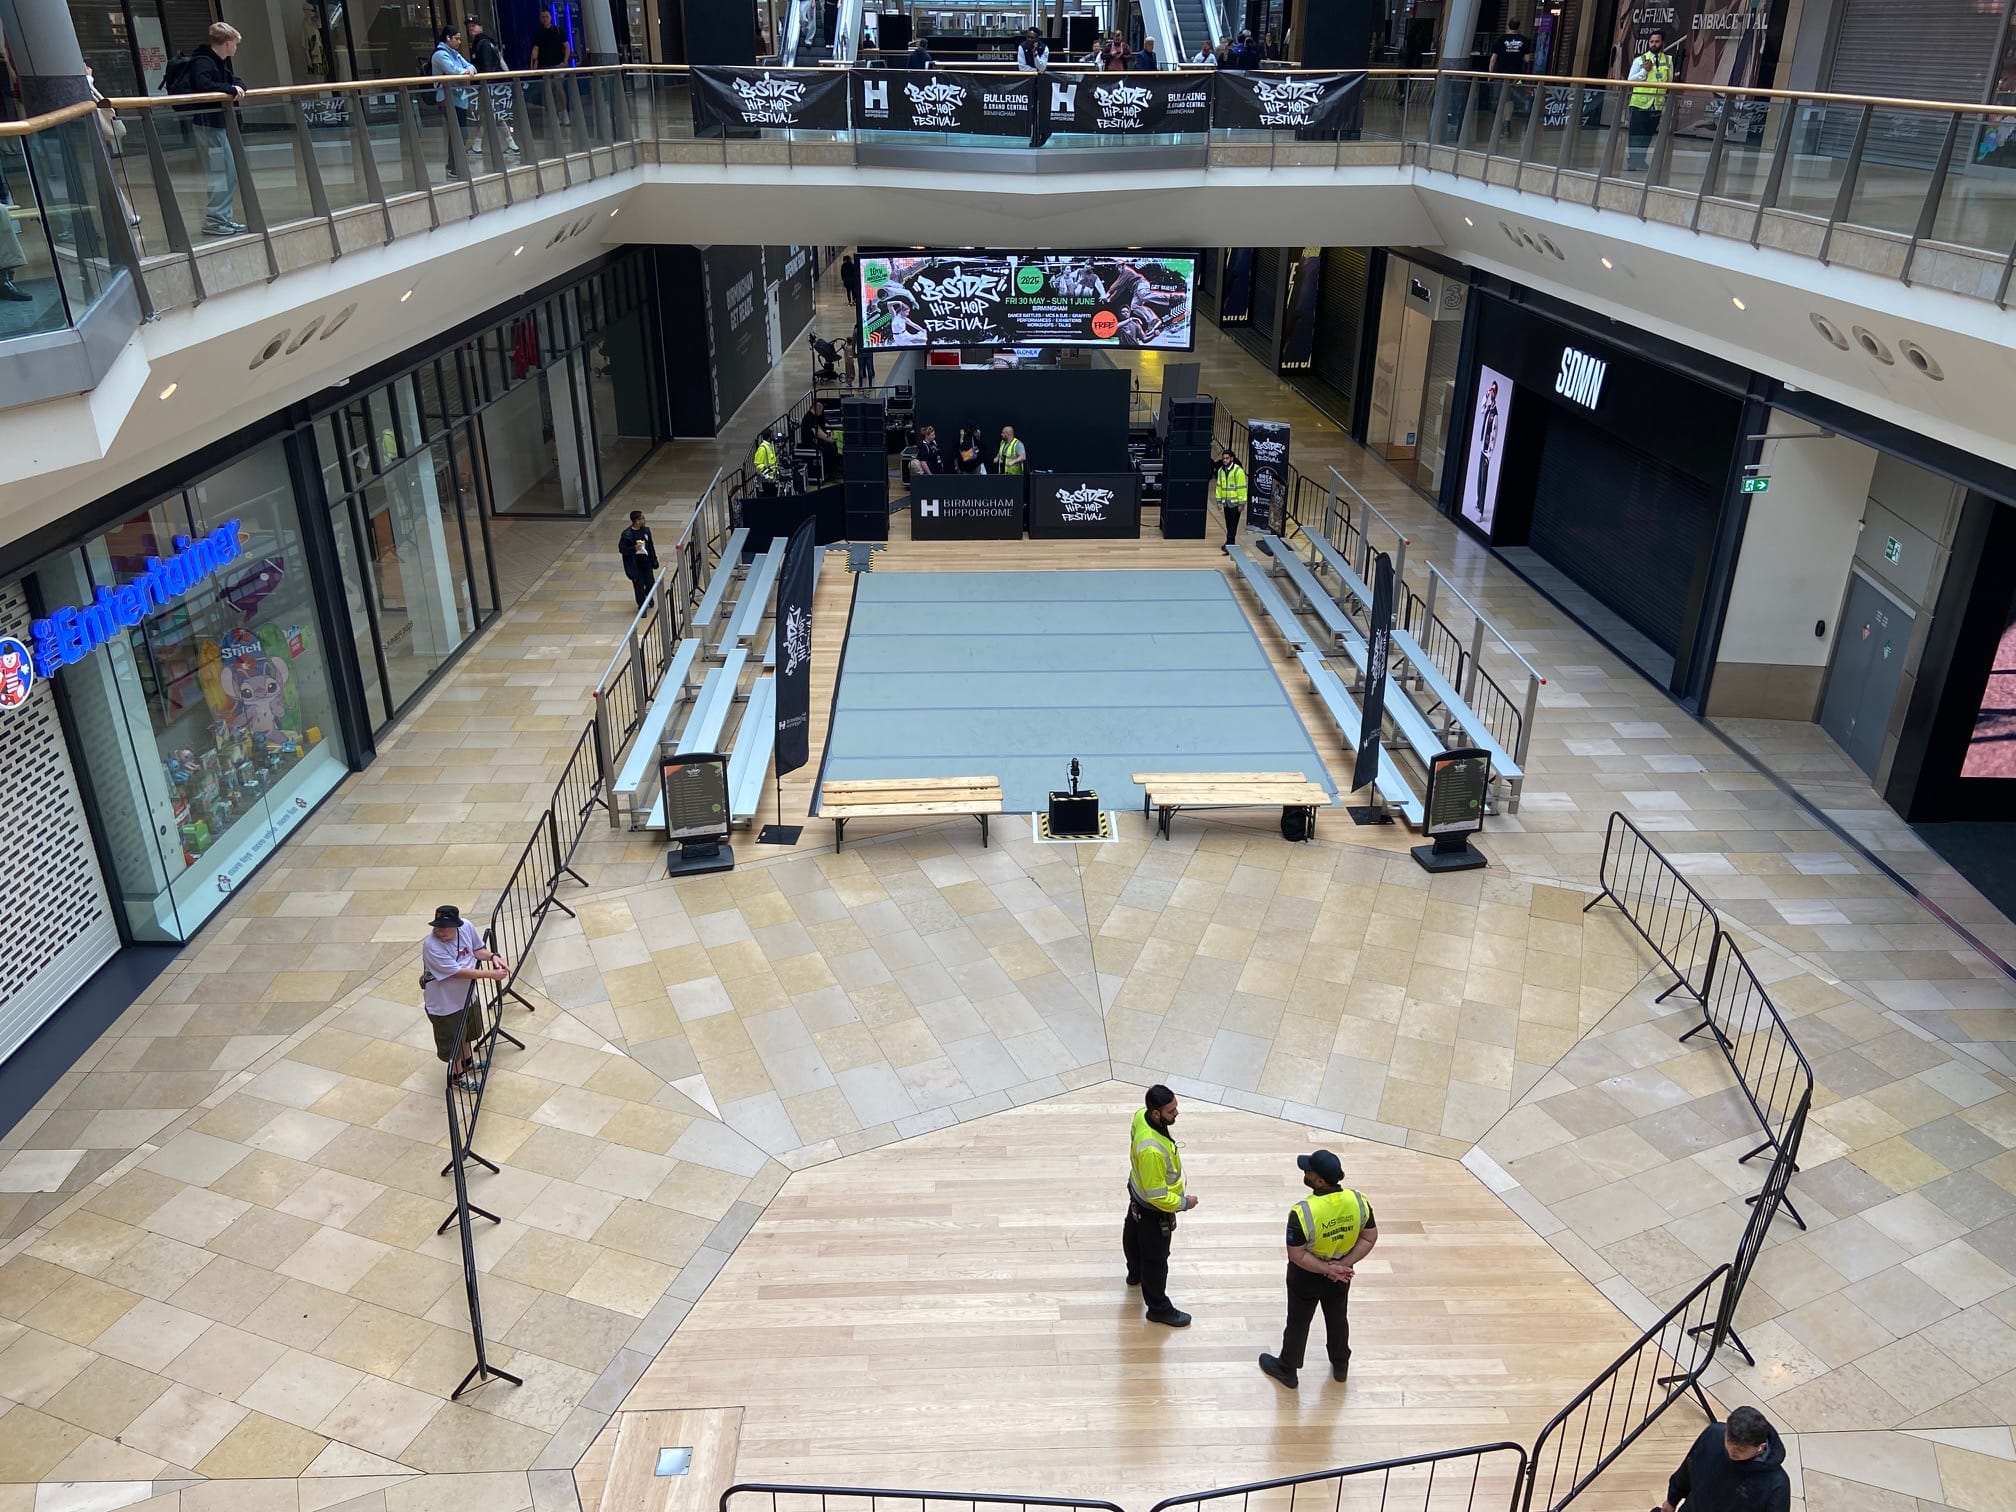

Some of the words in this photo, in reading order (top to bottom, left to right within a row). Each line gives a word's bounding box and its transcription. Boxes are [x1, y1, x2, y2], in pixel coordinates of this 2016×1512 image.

[1632, 8, 1674, 24] CAFFEINE
[1692, 13, 1738, 30] EMBRACE
[864, 81, 887, 108] H
[984, 94, 1028, 103] BULLRING
[1051, 82, 1077, 111] H
[1168, 93, 1206, 101] BULLRING
[1021, 276, 1039, 284] 2025
[924, 315, 996, 331] FESTIVAL
[1555, 347, 1606, 410] SDMN
[921, 499, 939, 517] H
[943, 499, 1014, 508] BIRMINGHAM
[943, 508, 1013, 517] HIPPODROME
[50, 518, 243, 664] Entertainer
